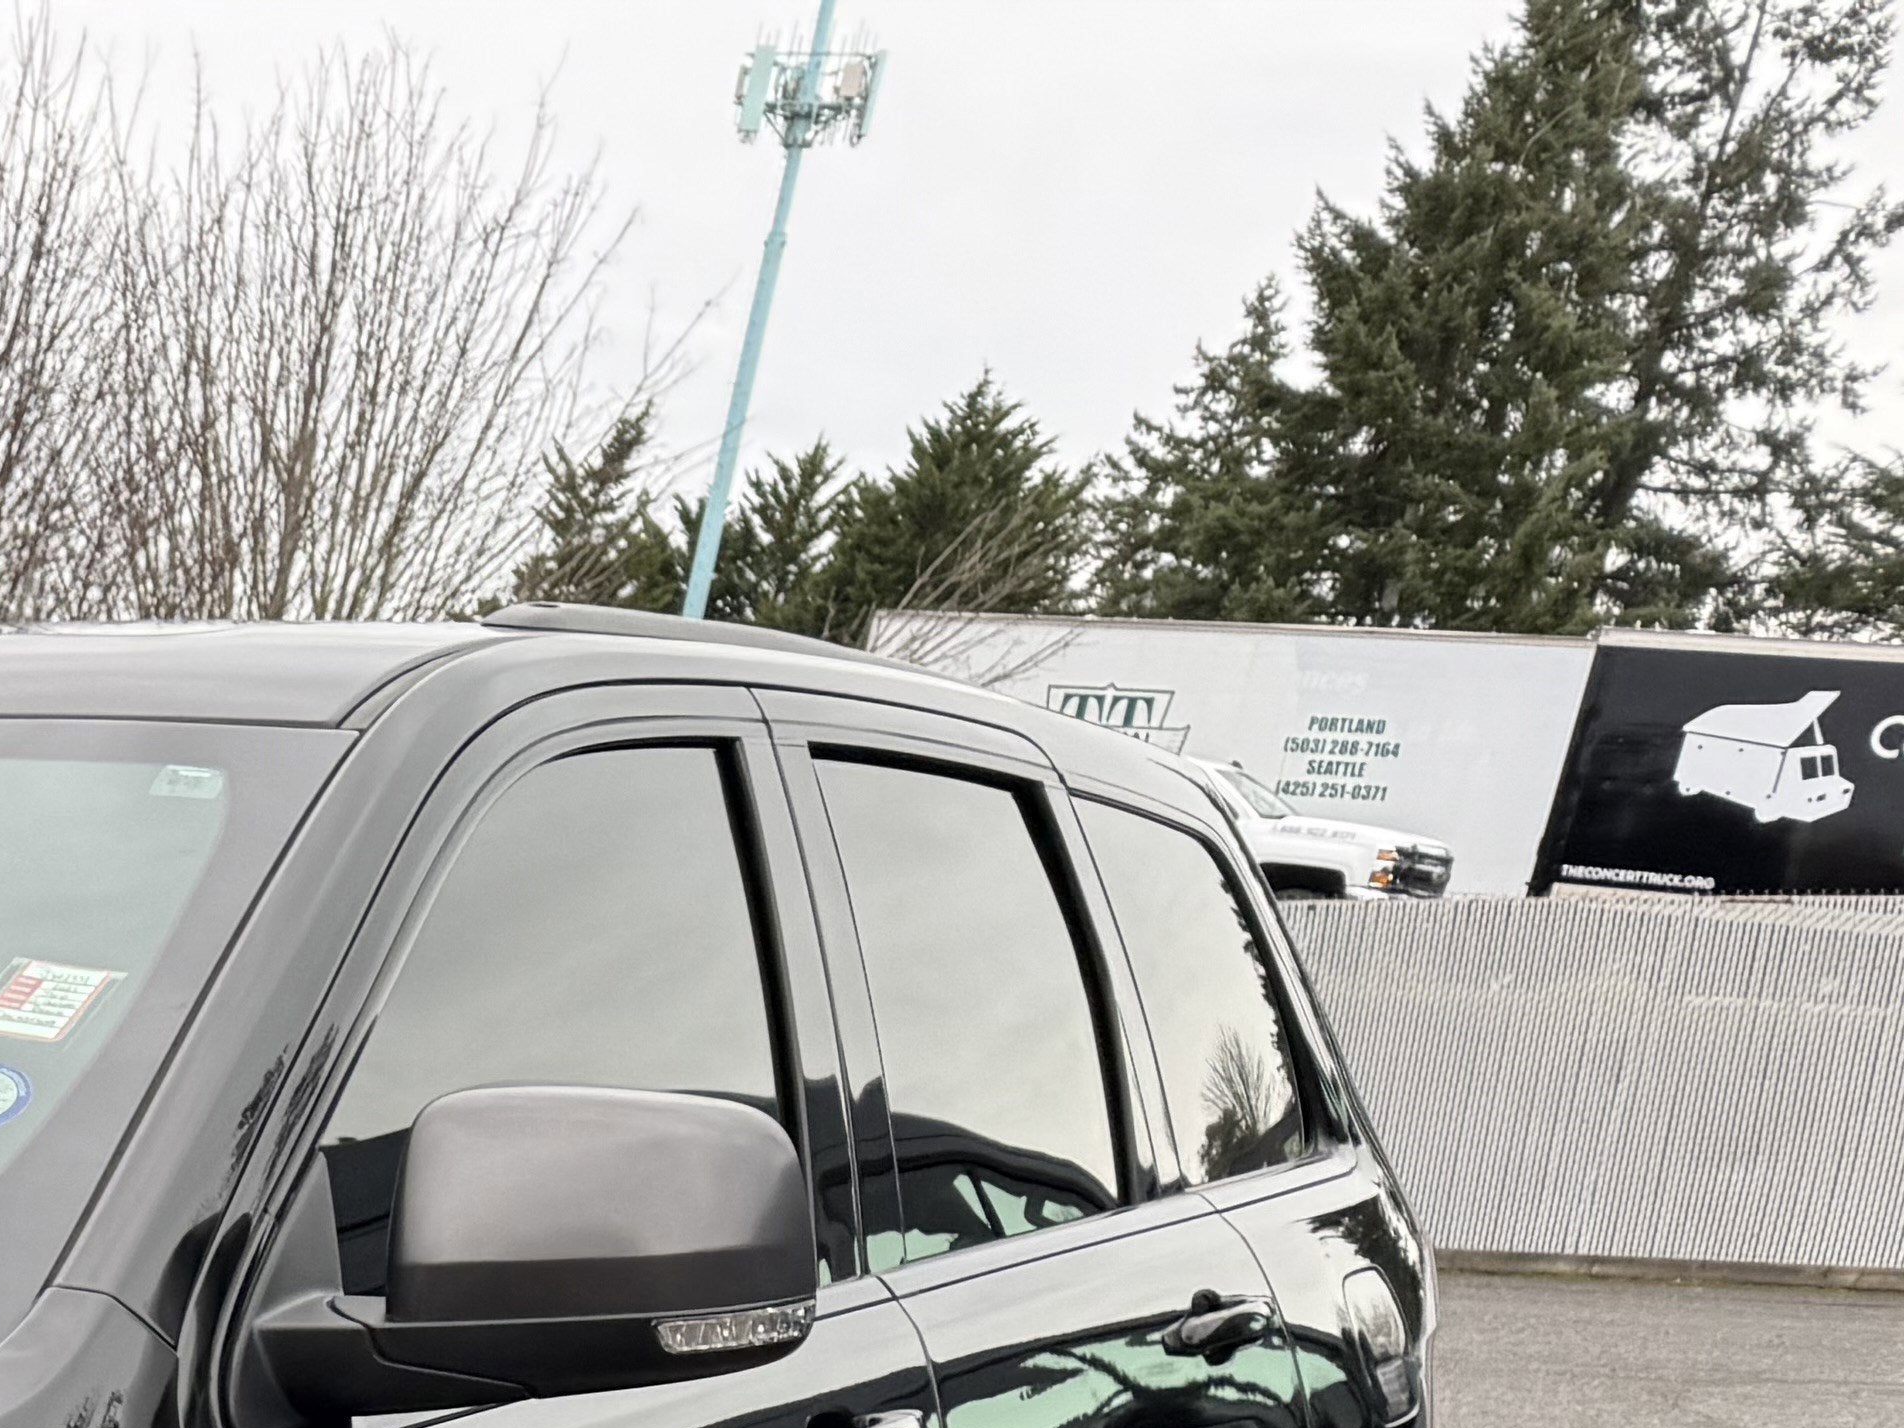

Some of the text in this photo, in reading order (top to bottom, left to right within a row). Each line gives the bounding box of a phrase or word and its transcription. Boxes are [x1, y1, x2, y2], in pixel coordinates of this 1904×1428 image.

[1307, 715, 1387, 735] PORTLAND
[1283, 736, 1401, 758] (503) 288-7164
[1306, 760, 1368, 778] SEATTLE
[1275, 779, 1388, 801] (425) 251-0371
[1561, 863, 1716, 890] THECONCERTTRUCK.ORG
